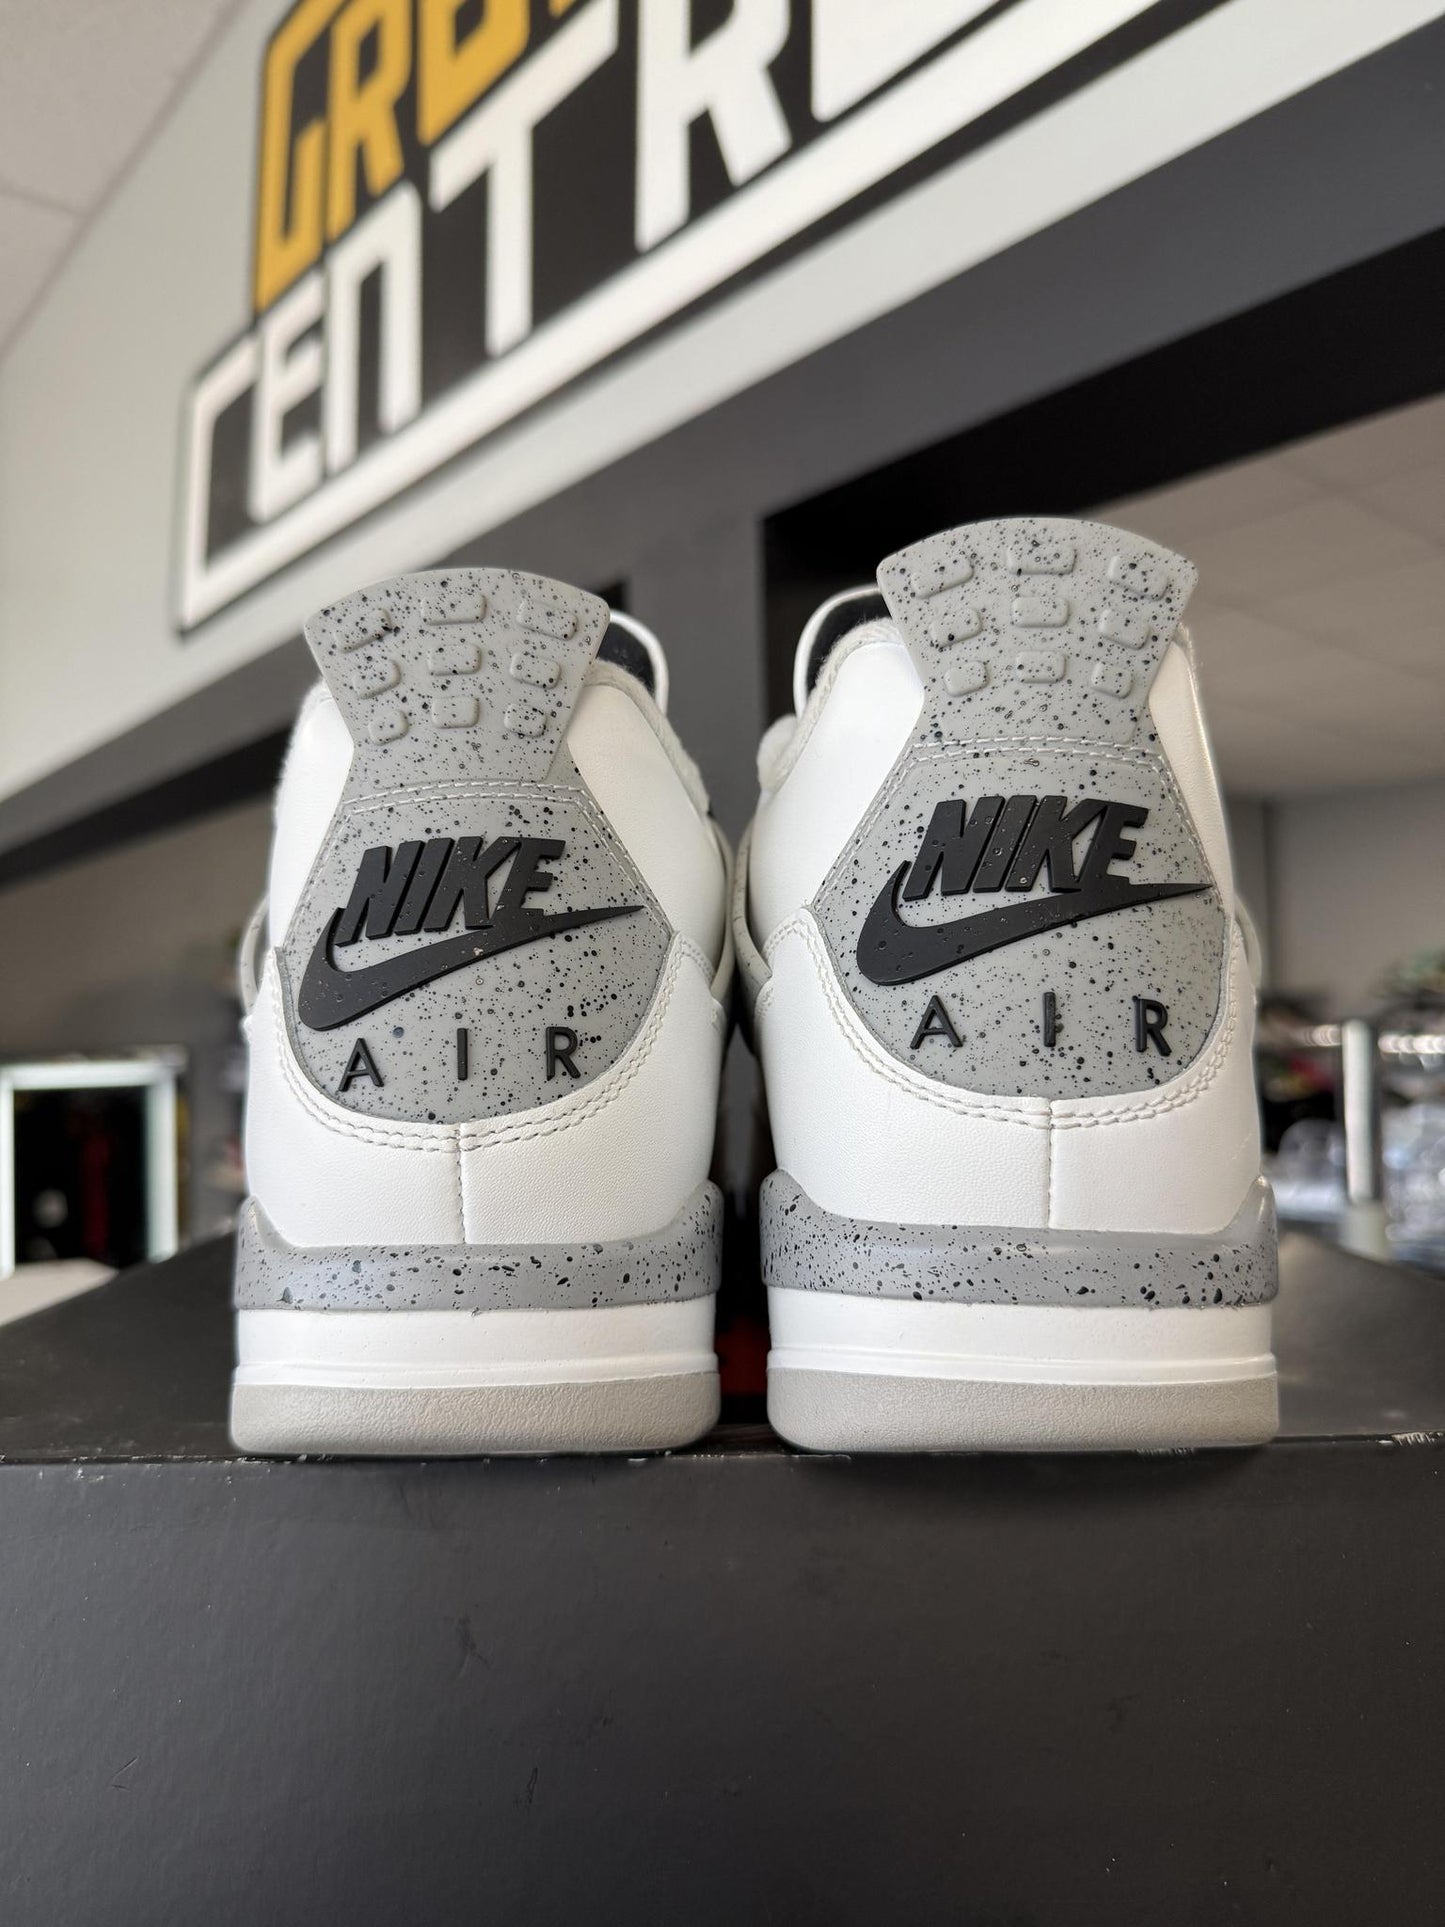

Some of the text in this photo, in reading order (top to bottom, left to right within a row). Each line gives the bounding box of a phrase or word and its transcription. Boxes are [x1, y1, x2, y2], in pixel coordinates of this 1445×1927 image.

[902, 795, 1149, 900] NIKE
[334, 835, 566, 947] NIKE
[339, 1026, 582, 1092] AIR
[910, 991, 1172, 1057] AIR
